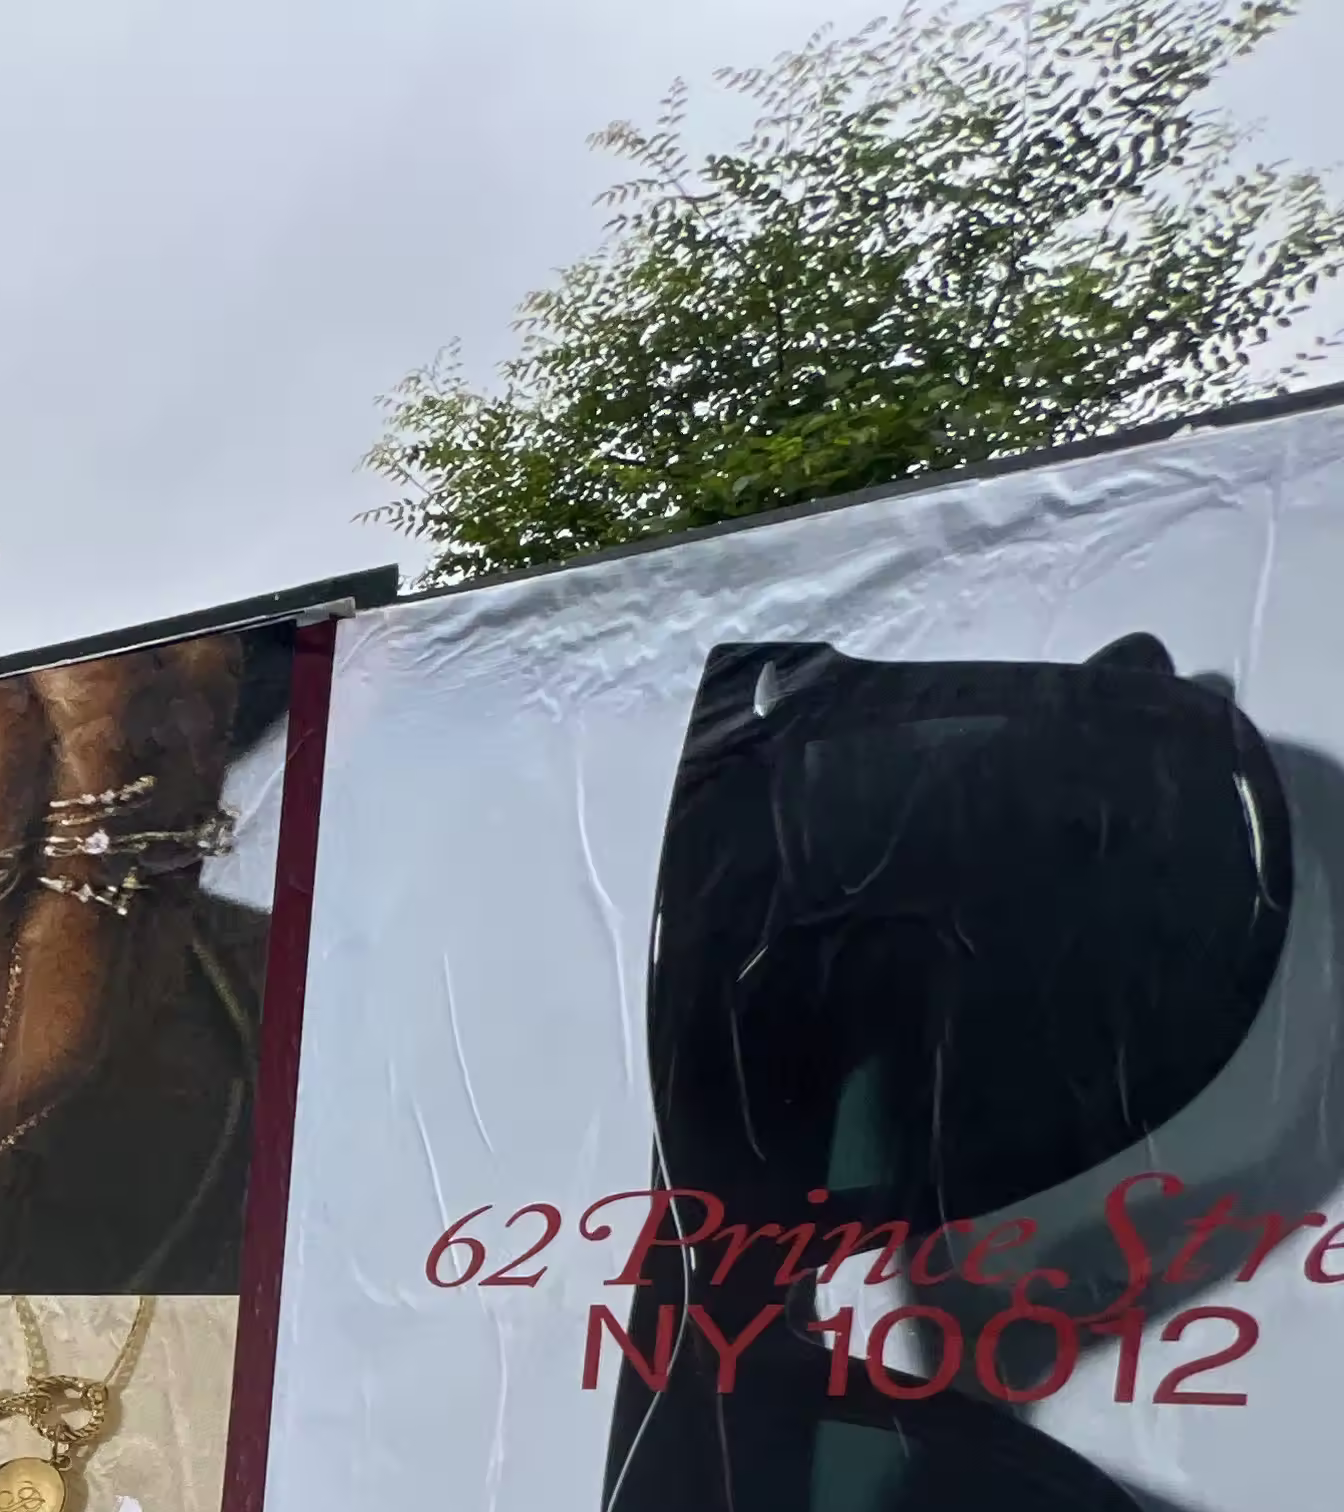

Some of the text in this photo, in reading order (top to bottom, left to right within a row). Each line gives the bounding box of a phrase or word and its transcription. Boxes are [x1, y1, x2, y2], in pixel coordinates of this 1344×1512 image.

[423, 1202, 562, 1290] 62
[578, 1188, 1039, 1288] Prince
[580, 1302, 1261, 1406] NY 10012
